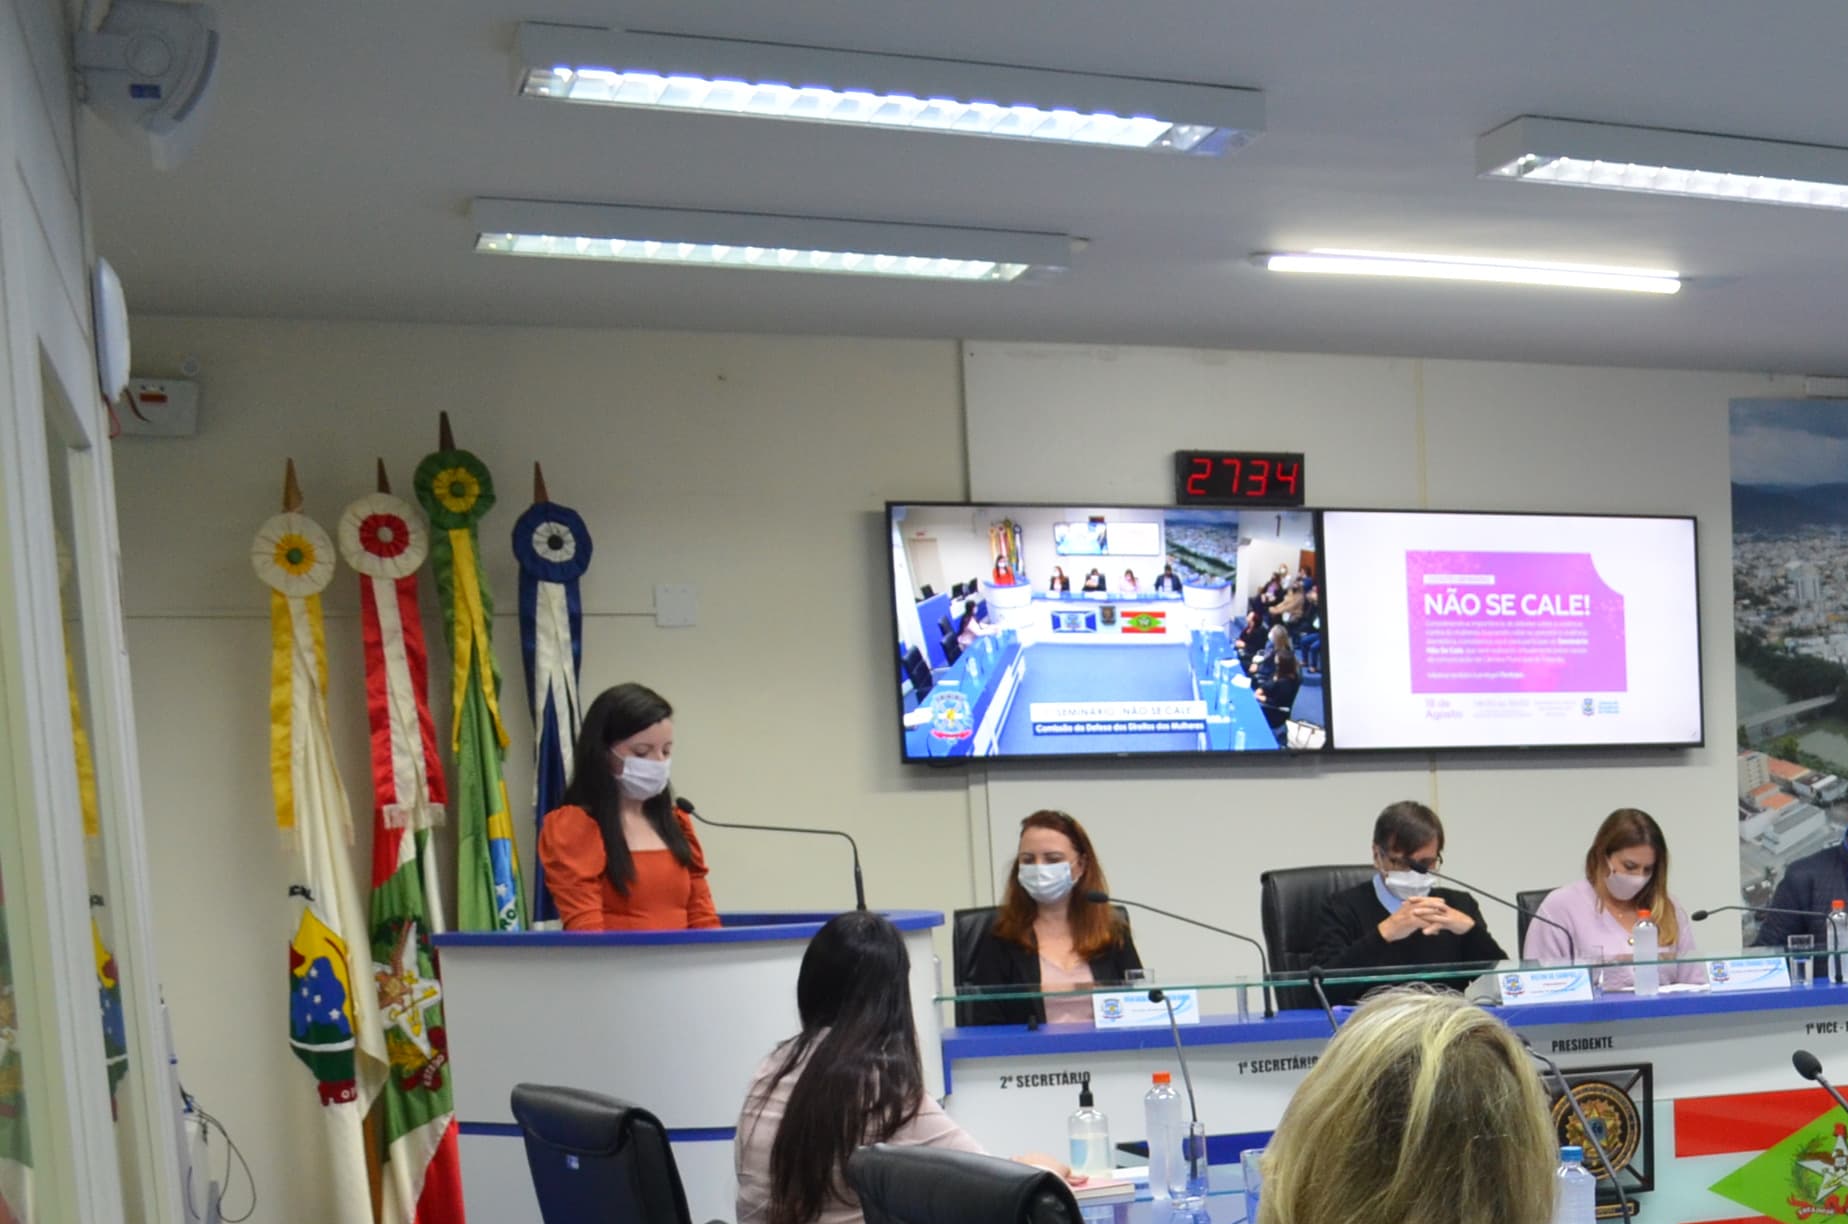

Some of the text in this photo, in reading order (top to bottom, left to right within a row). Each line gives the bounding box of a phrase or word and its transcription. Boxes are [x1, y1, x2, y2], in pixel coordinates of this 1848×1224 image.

[1424, 588, 1592, 617] NÃO SE CALE!
[1816, 1021, 1838, 1034] VICE
[1552, 1036, 1613, 1052] PRESIDENTE
[1016, 1070, 1091, 1088] SECRETÁRIO
